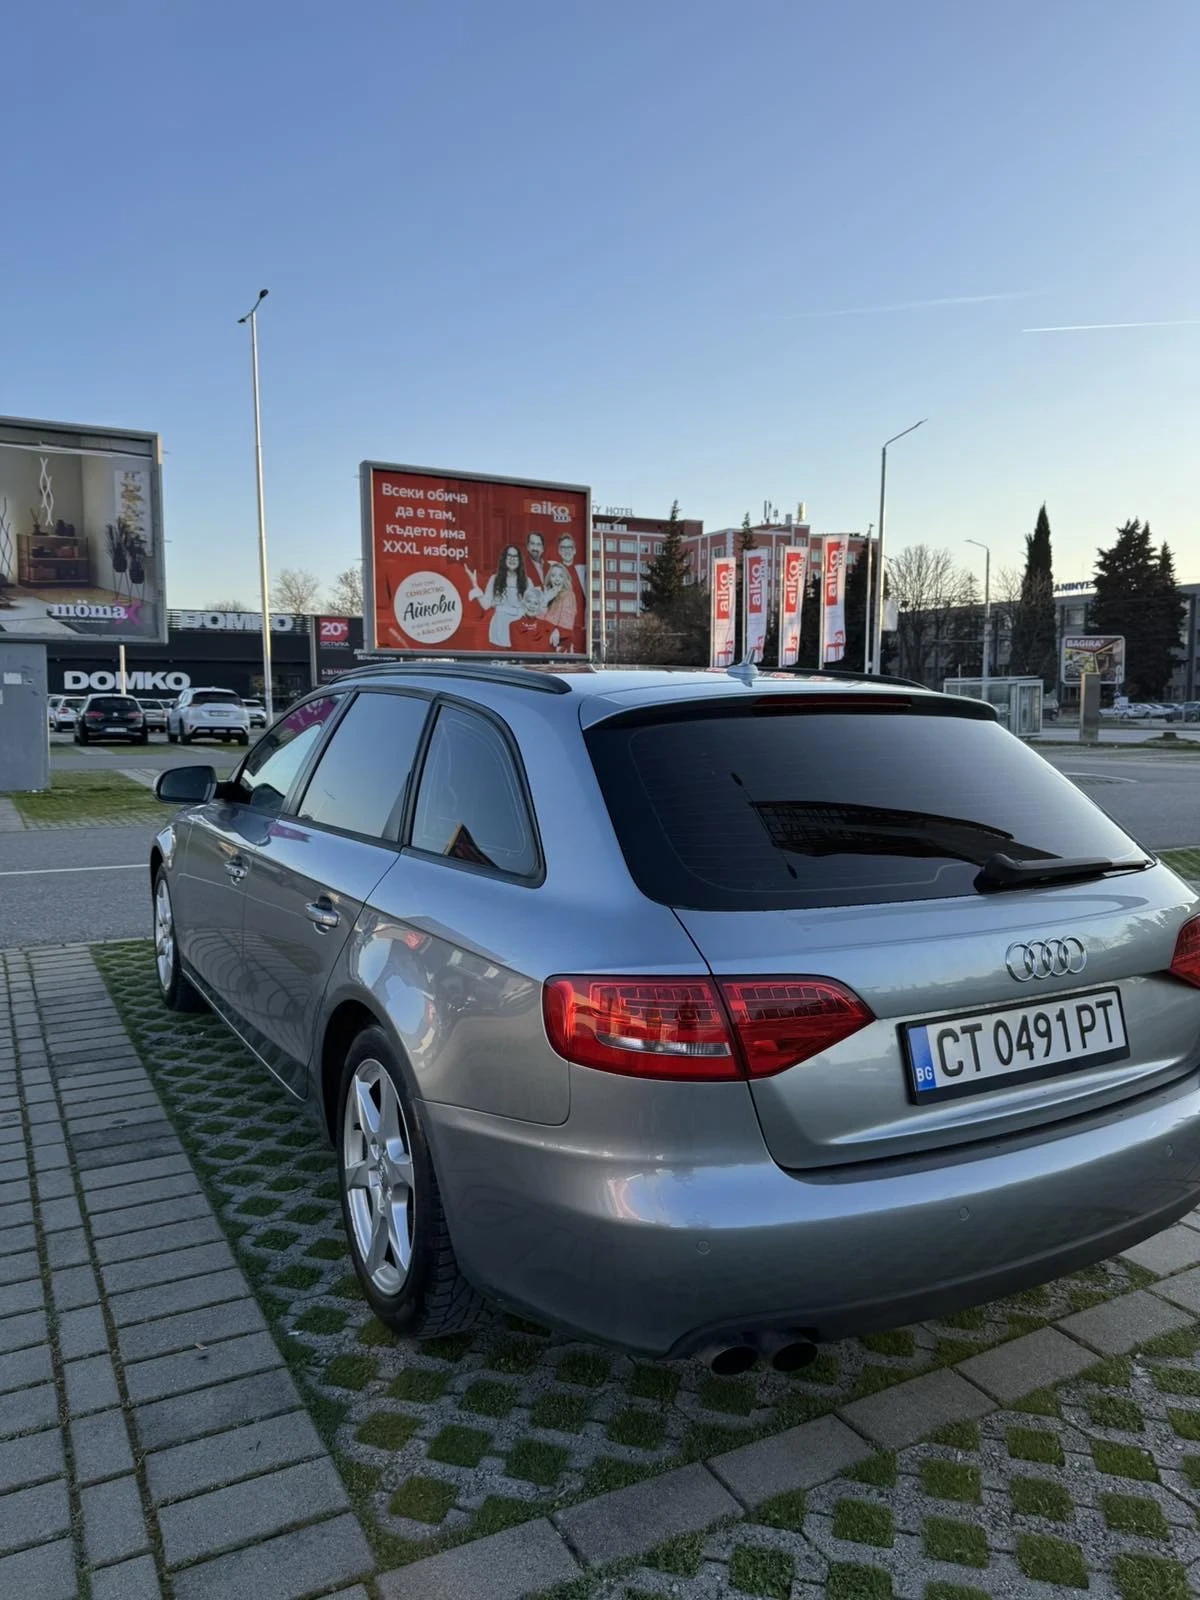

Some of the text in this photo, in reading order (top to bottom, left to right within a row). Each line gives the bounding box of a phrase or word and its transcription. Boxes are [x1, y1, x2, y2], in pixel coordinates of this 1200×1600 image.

[382, 483, 468, 504] Всеки обича
[395, 506, 456, 522] да е там,
[530, 501, 569, 516] aiko
[606, 506, 632, 516] HOTEL
[386, 524, 466, 540] където има
[383, 540, 468, 560] XXXL избор!
[787, 561, 799, 605] aiko
[827, 550, 838, 597] aiko
[717, 571, 730, 612] aiko
[749, 564, 761, 606] aiko
[403, 594, 456, 621] Айкови
[64, 671, 191, 691] DOMKO
[936, 1000, 1113, 1078] CT 0491 PT
[916, 1067, 933, 1083] BG
